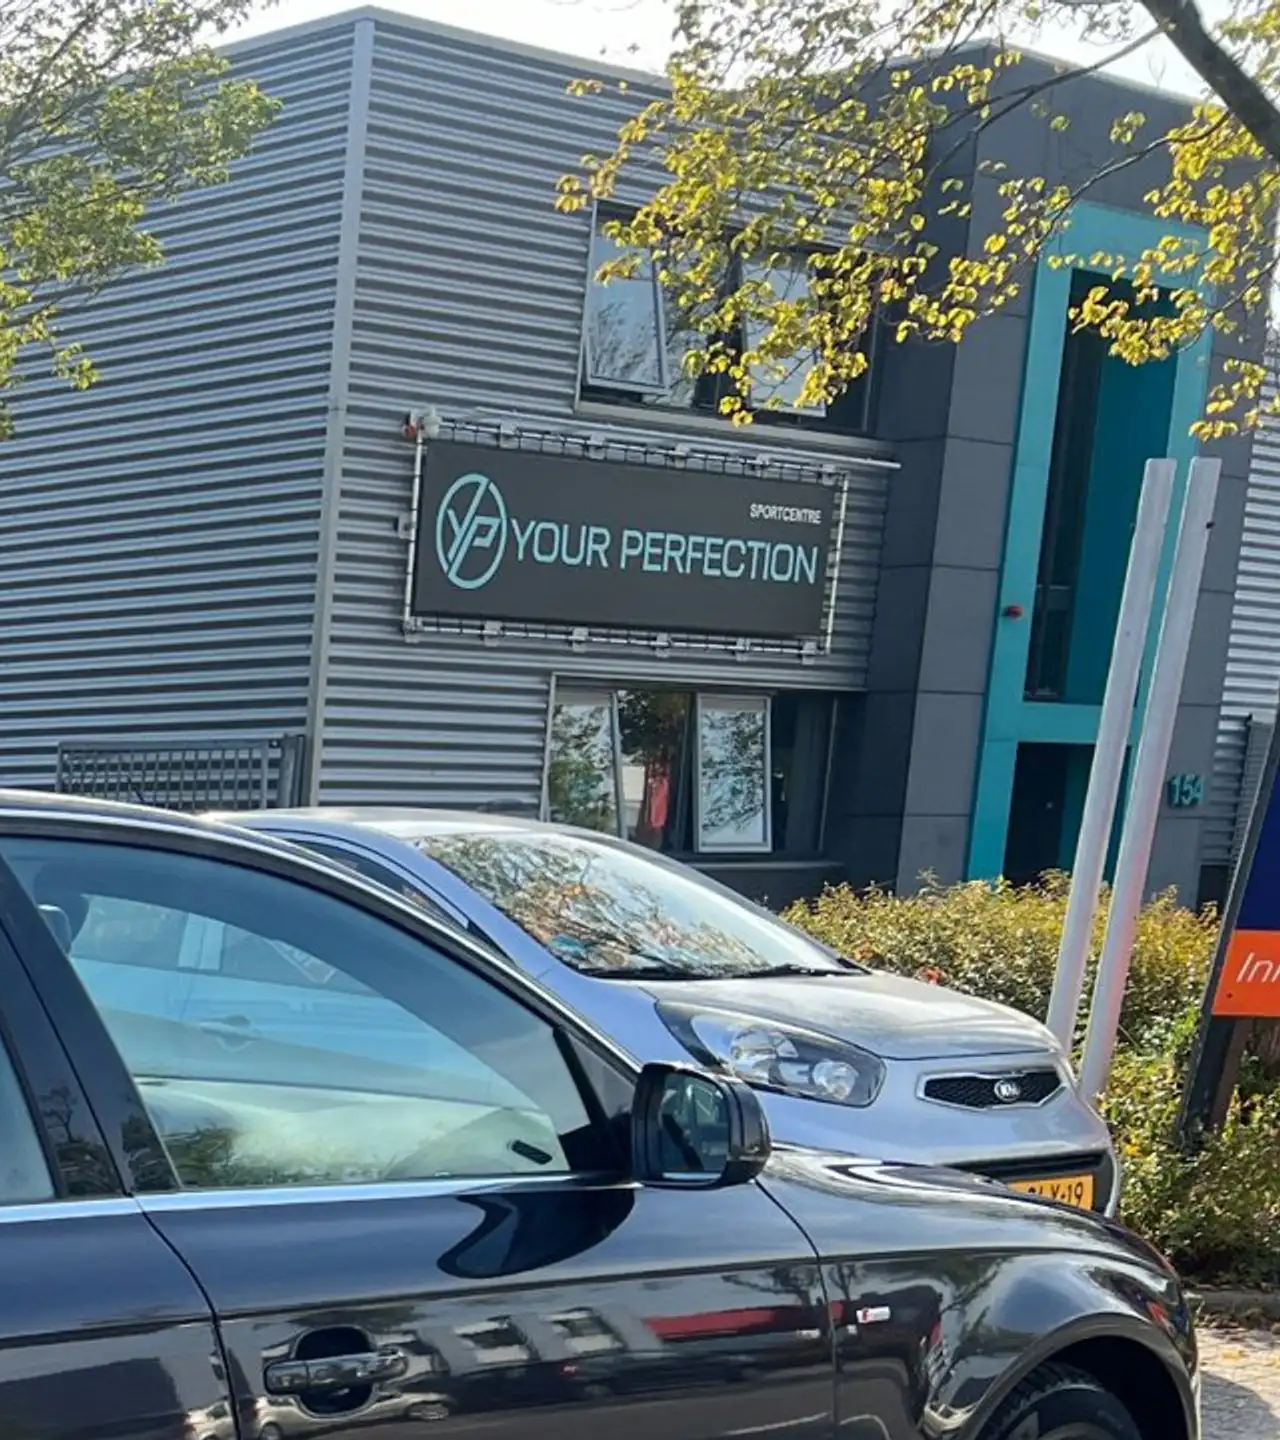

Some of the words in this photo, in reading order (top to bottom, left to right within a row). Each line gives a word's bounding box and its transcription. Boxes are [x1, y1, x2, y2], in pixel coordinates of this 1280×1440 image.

[749, 503, 822, 524] SPORTCENTRE
[510, 517, 610, 568] YOUR
[619, 529, 819, 585] PERFECTION
[1171, 774, 1204, 806] 154
